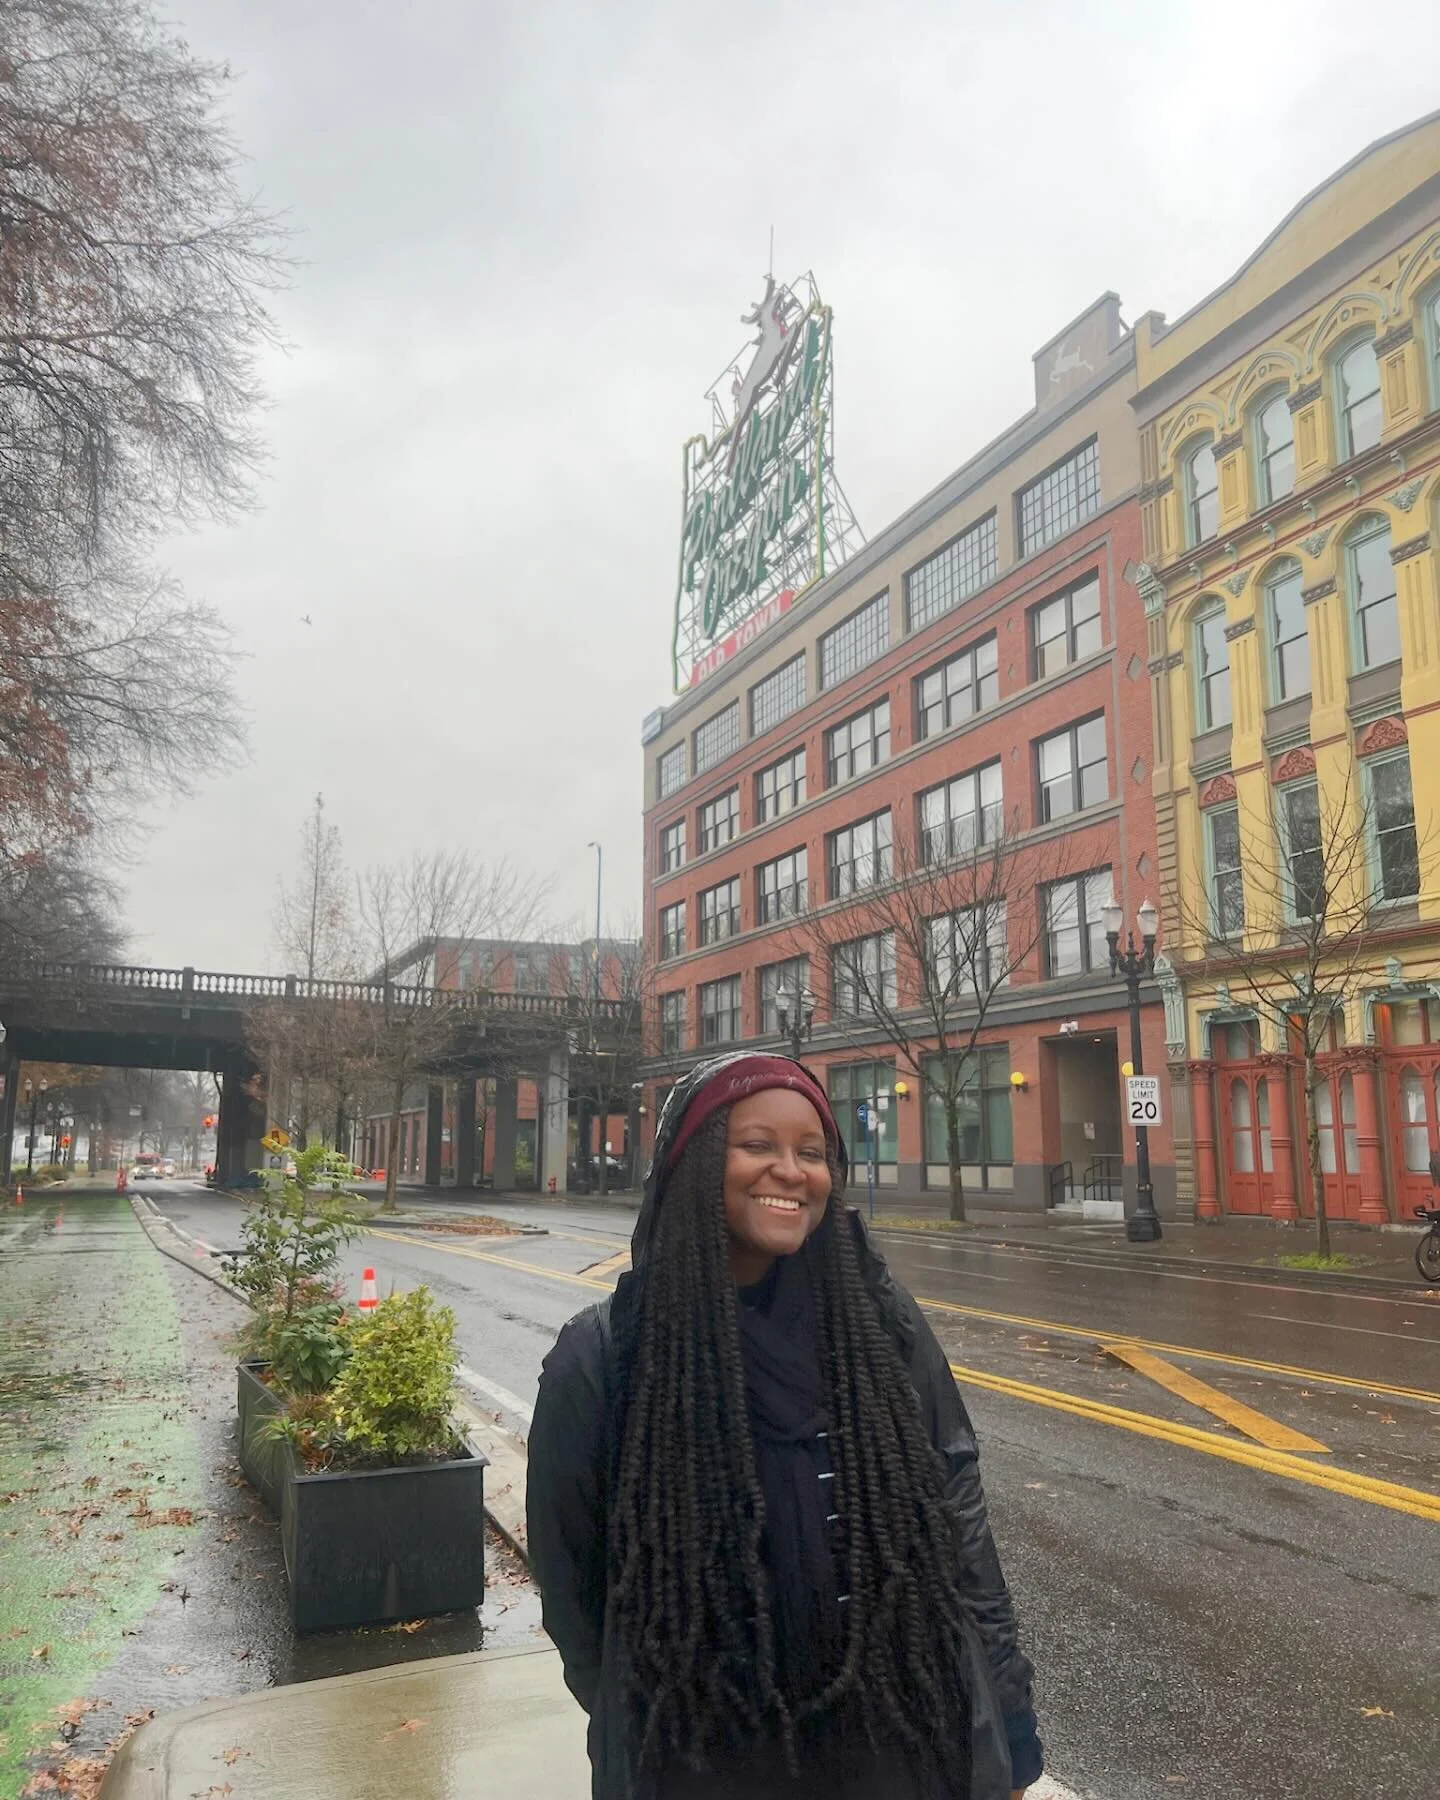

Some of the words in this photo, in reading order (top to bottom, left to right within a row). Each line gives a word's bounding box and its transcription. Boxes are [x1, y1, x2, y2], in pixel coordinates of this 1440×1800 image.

[682, 318, 818, 588] Portland
[701, 458, 807, 638] Oregon
[699, 646, 725, 682] OLD
[735, 600, 781, 656] TOWN
[1129, 1080, 1156, 1089] SPEED
[1132, 1090, 1154, 1099] LIMIT
[1131, 1101, 1157, 1119] 20
